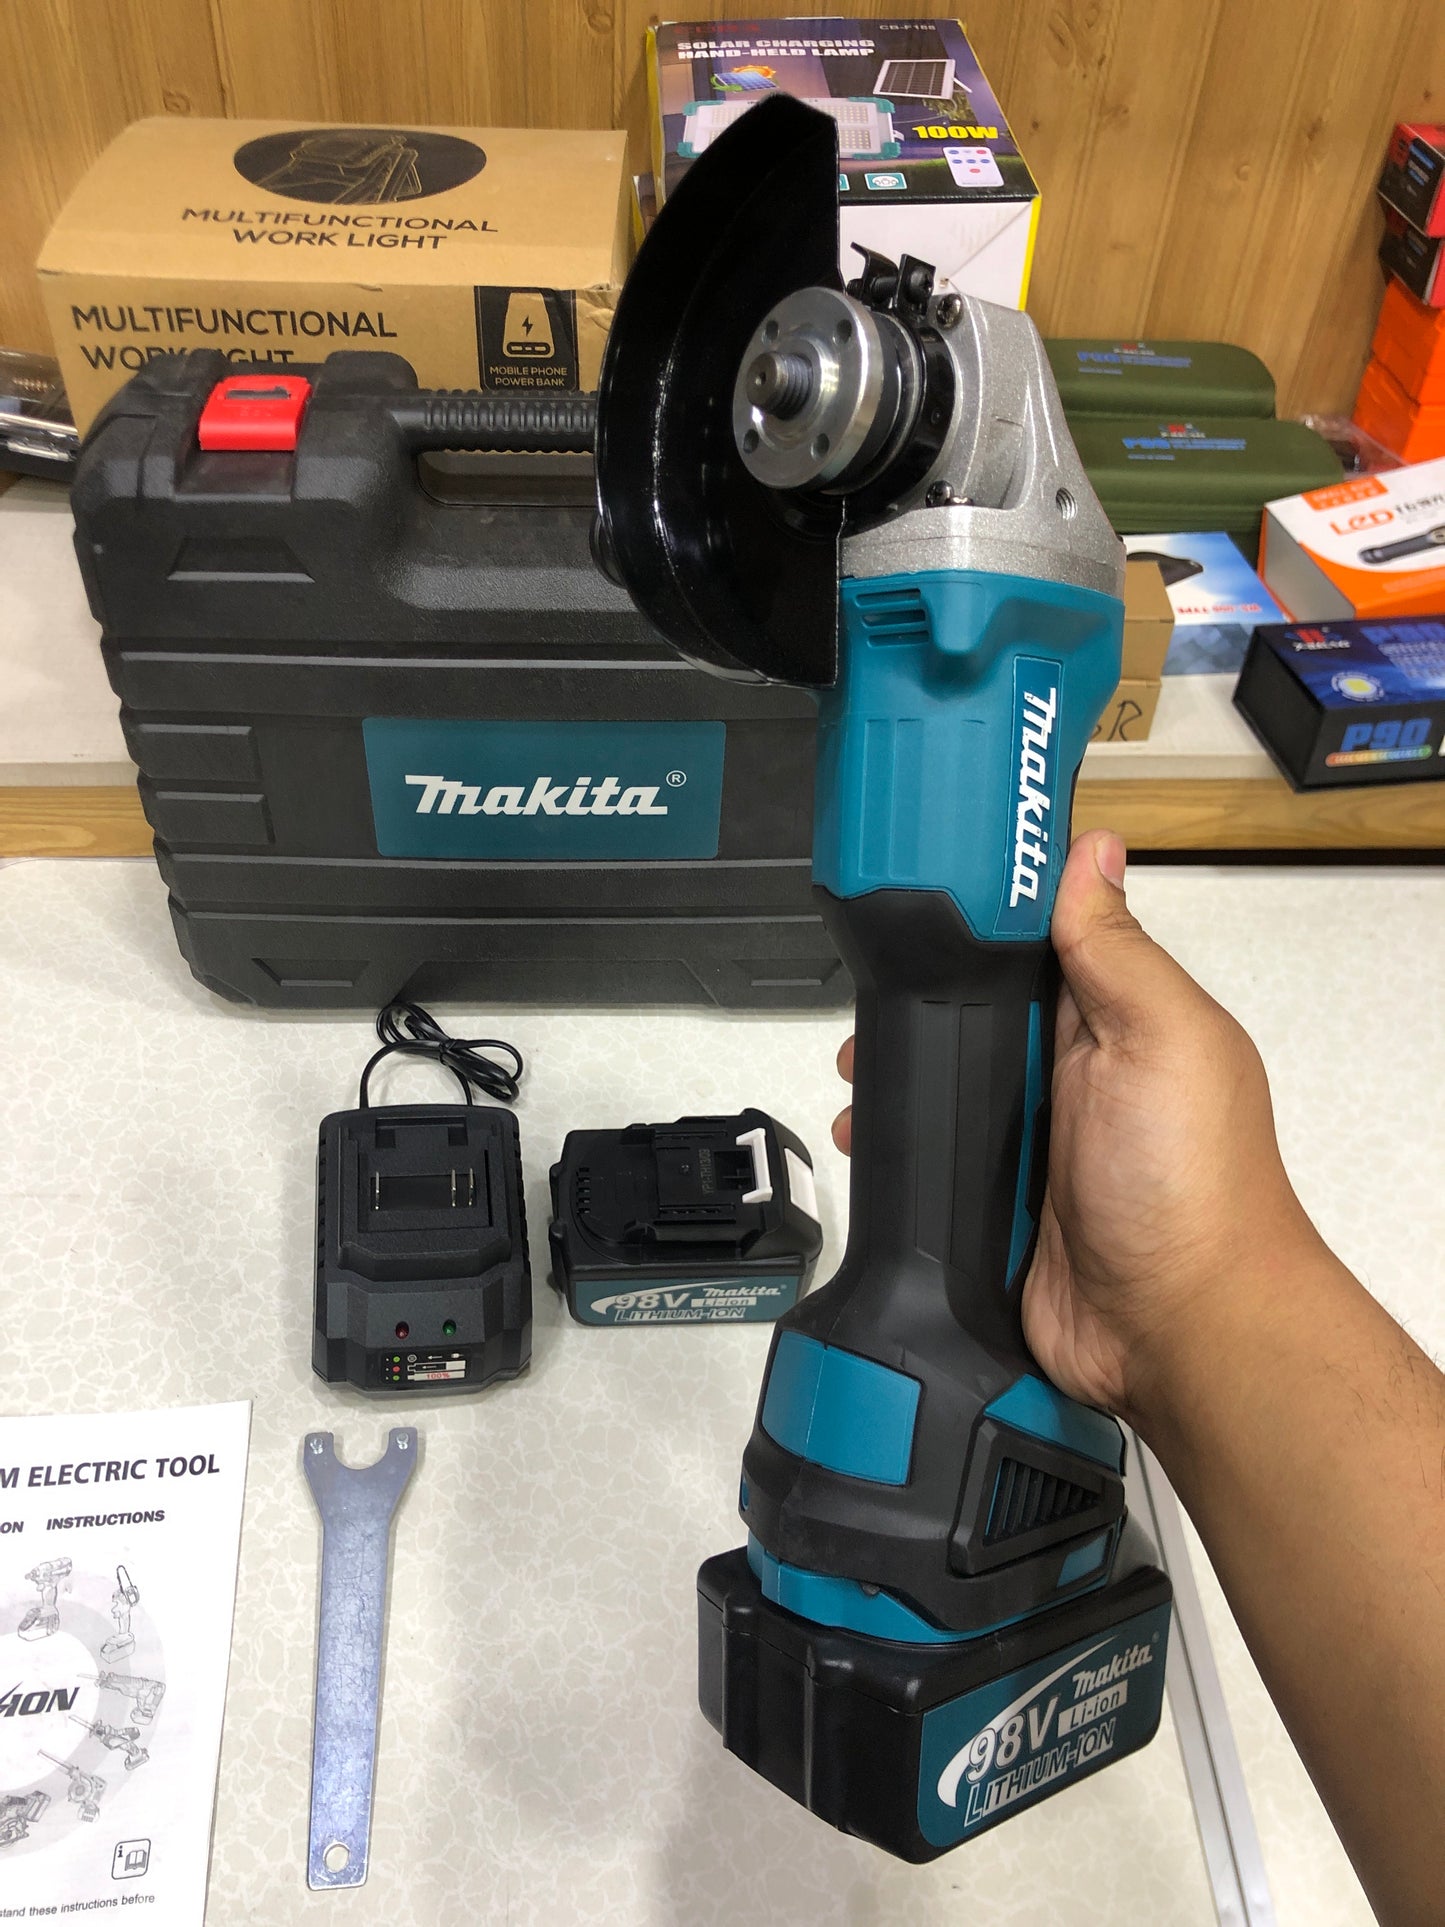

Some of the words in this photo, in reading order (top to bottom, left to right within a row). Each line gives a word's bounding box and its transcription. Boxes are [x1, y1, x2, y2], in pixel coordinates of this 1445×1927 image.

[677, 40, 750, 50] SOLAR
[755, 39, 876, 48] CHARGING
[677, 49, 807, 59] HAND-HELD
[811, 48, 876, 57] LAMP
[912, 125, 999, 139] 100W
[181, 208, 499, 232] MULTIFUNCTIONAL
[232, 228, 338, 247] WORK
[347, 233, 448, 249] LIGHT
[71, 305, 398, 338] MULTIFUNCTIONAL
[489, 366, 529, 375] MOBILE
[530, 367, 568, 376] PHONE
[494, 377, 535, 386] POWER
[536, 378, 565, 387] BANK
[1340, 717, 1432, 752] P90
[614, 1293, 691, 1309] 98V
[614, 1308, 746, 1322] LITHIUM-ION
[28, 1459, 148, 1488] ELECTRIC
[156, 1454, 220, 1478] TOOL
[46, 1510, 166, 1531] INSTRUCTIONS
[965, 1694, 1060, 1784] 98V
[1069, 1689, 1122, 1730] Li-ion
[964, 1717, 1117, 1828] LITHIUM-ION
[29, 1905, 58, 1917] these
[60, 1896, 118, 1913] instructions
[121, 1893, 155, 1906] before
